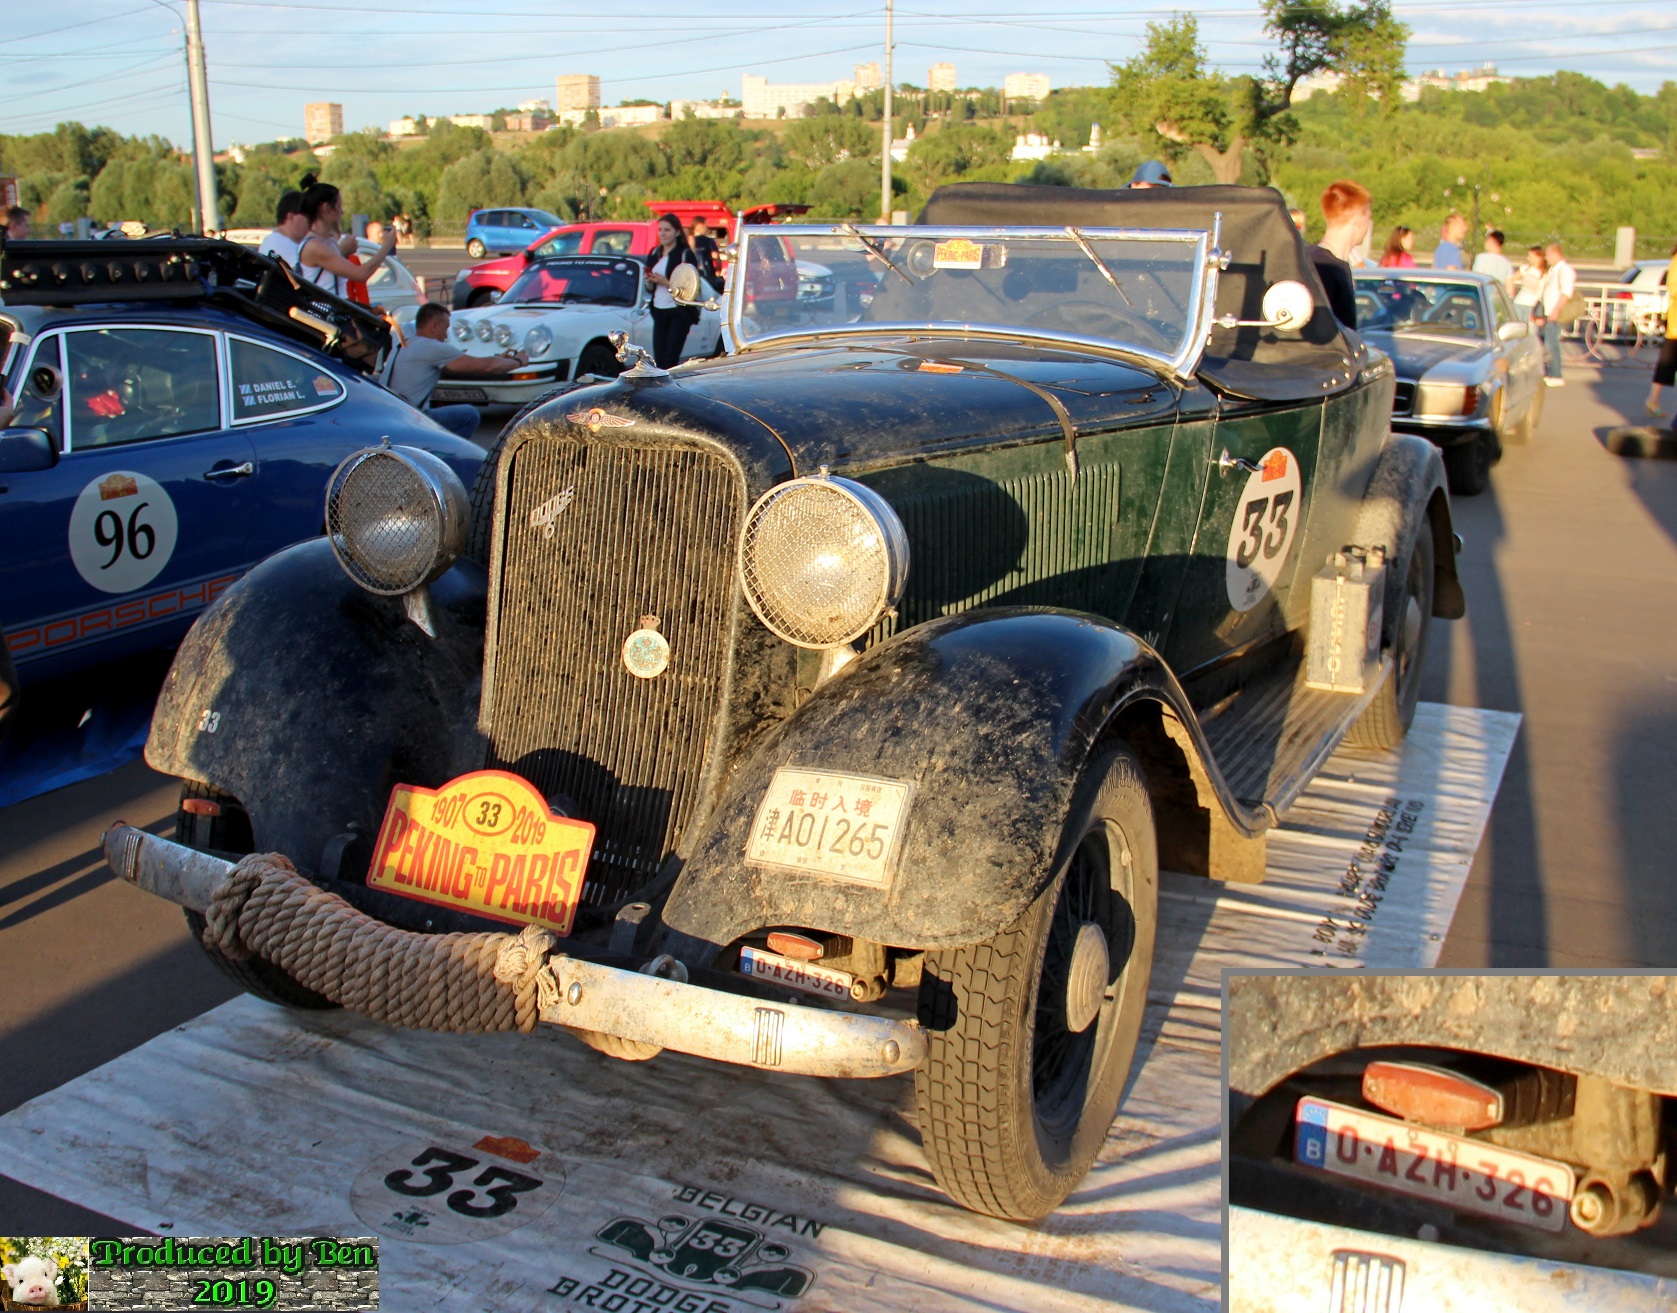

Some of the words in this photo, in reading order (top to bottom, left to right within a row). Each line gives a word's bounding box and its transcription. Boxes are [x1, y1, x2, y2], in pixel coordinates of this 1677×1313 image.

[253, 382, 286, 393] DANIEL
[286, 380, 296, 389] E.
[257, 394, 296, 404] FLORIAN
[296, 391, 306, 399] L.
[94, 502, 156, 570] 96
[1236, 490, 1294, 569] 33
[198, 709, 221, 734] 33
[789, 789, 873, 818] 临时入境
[431, 793, 467, 829] 1907
[475, 801, 502, 828] 33
[510, 805, 547, 845] 2019
[377, 808, 478, 901] PEKING
[474, 866, 486, 888] TO
[484, 849, 581, 924] PARIS
[744, 963, 751, 972] B
[1306, 1140, 1321, 1160] B
[384, 1146, 543, 1218] 33
[673, 1186, 826, 1238] BELGIAN
[689, 1229, 748, 1257] 33
